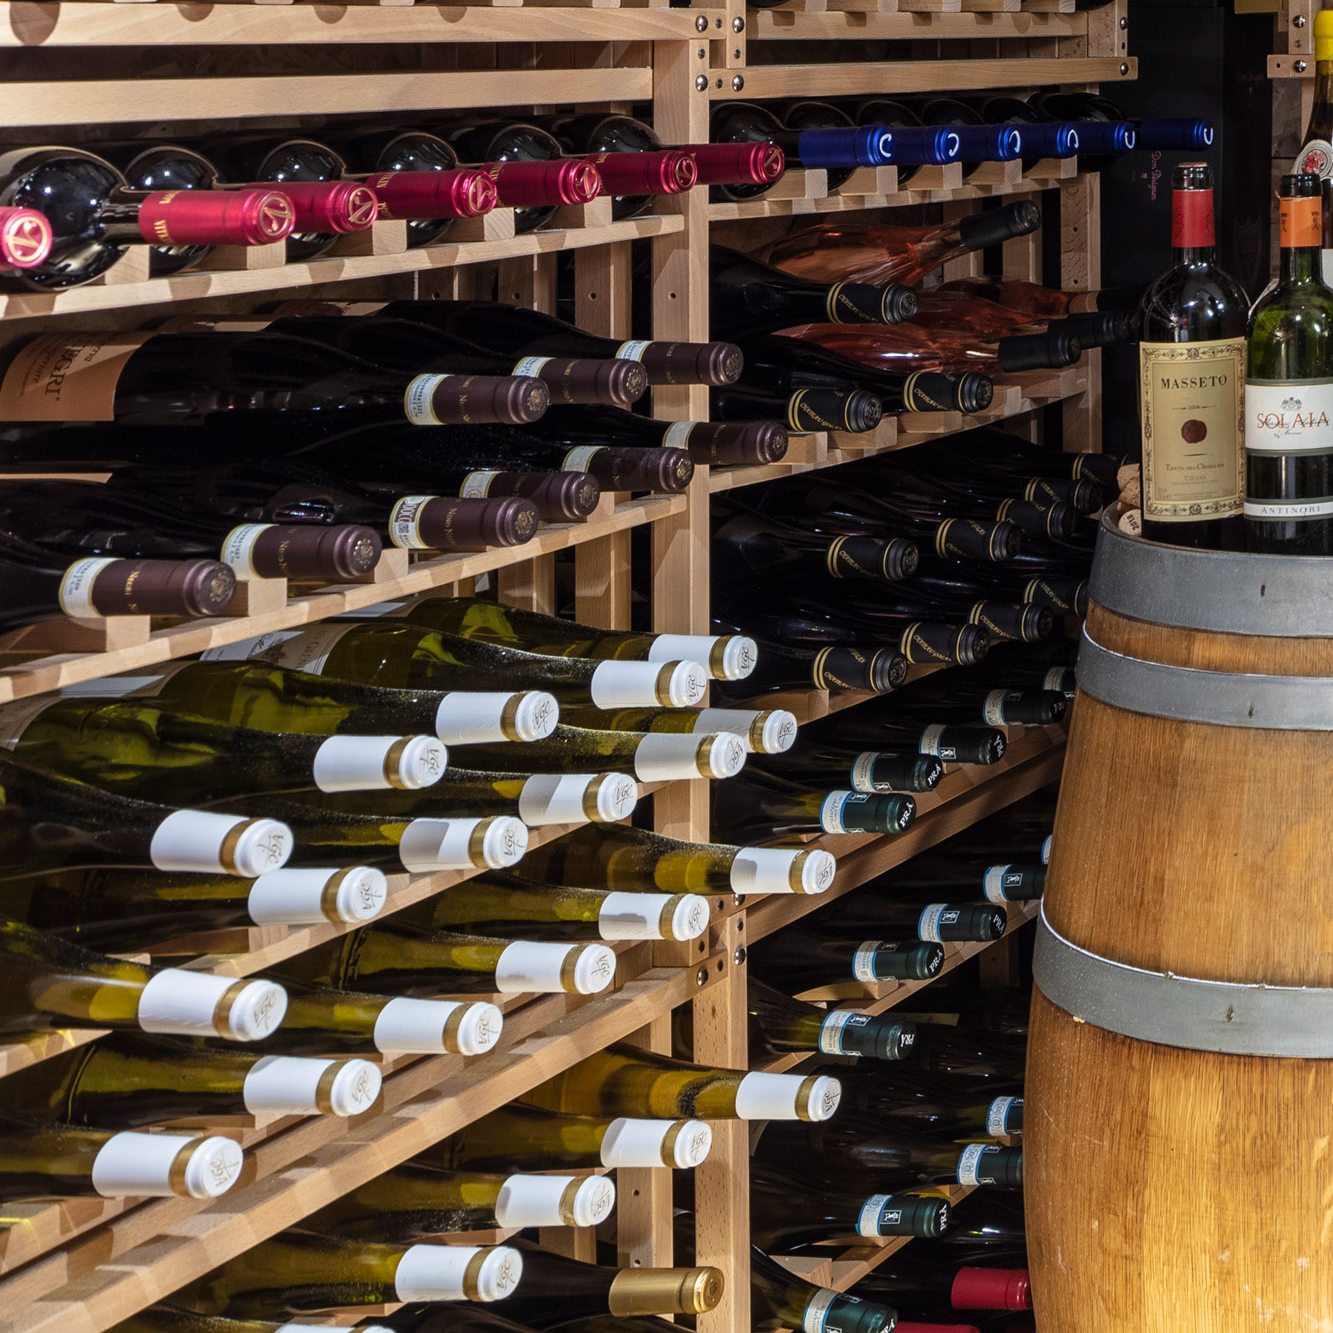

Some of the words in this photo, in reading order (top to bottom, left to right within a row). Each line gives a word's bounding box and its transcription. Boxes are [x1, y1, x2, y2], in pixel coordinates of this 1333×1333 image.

[1152, 150, 1161, 169] Dom
[1161, 374, 1227, 389] MASSETO
[1257, 411, 1330, 429] SOLAIA
[1261, 506, 1321, 515] ANTINORI
[1126, 514, 1140, 531] 2018
